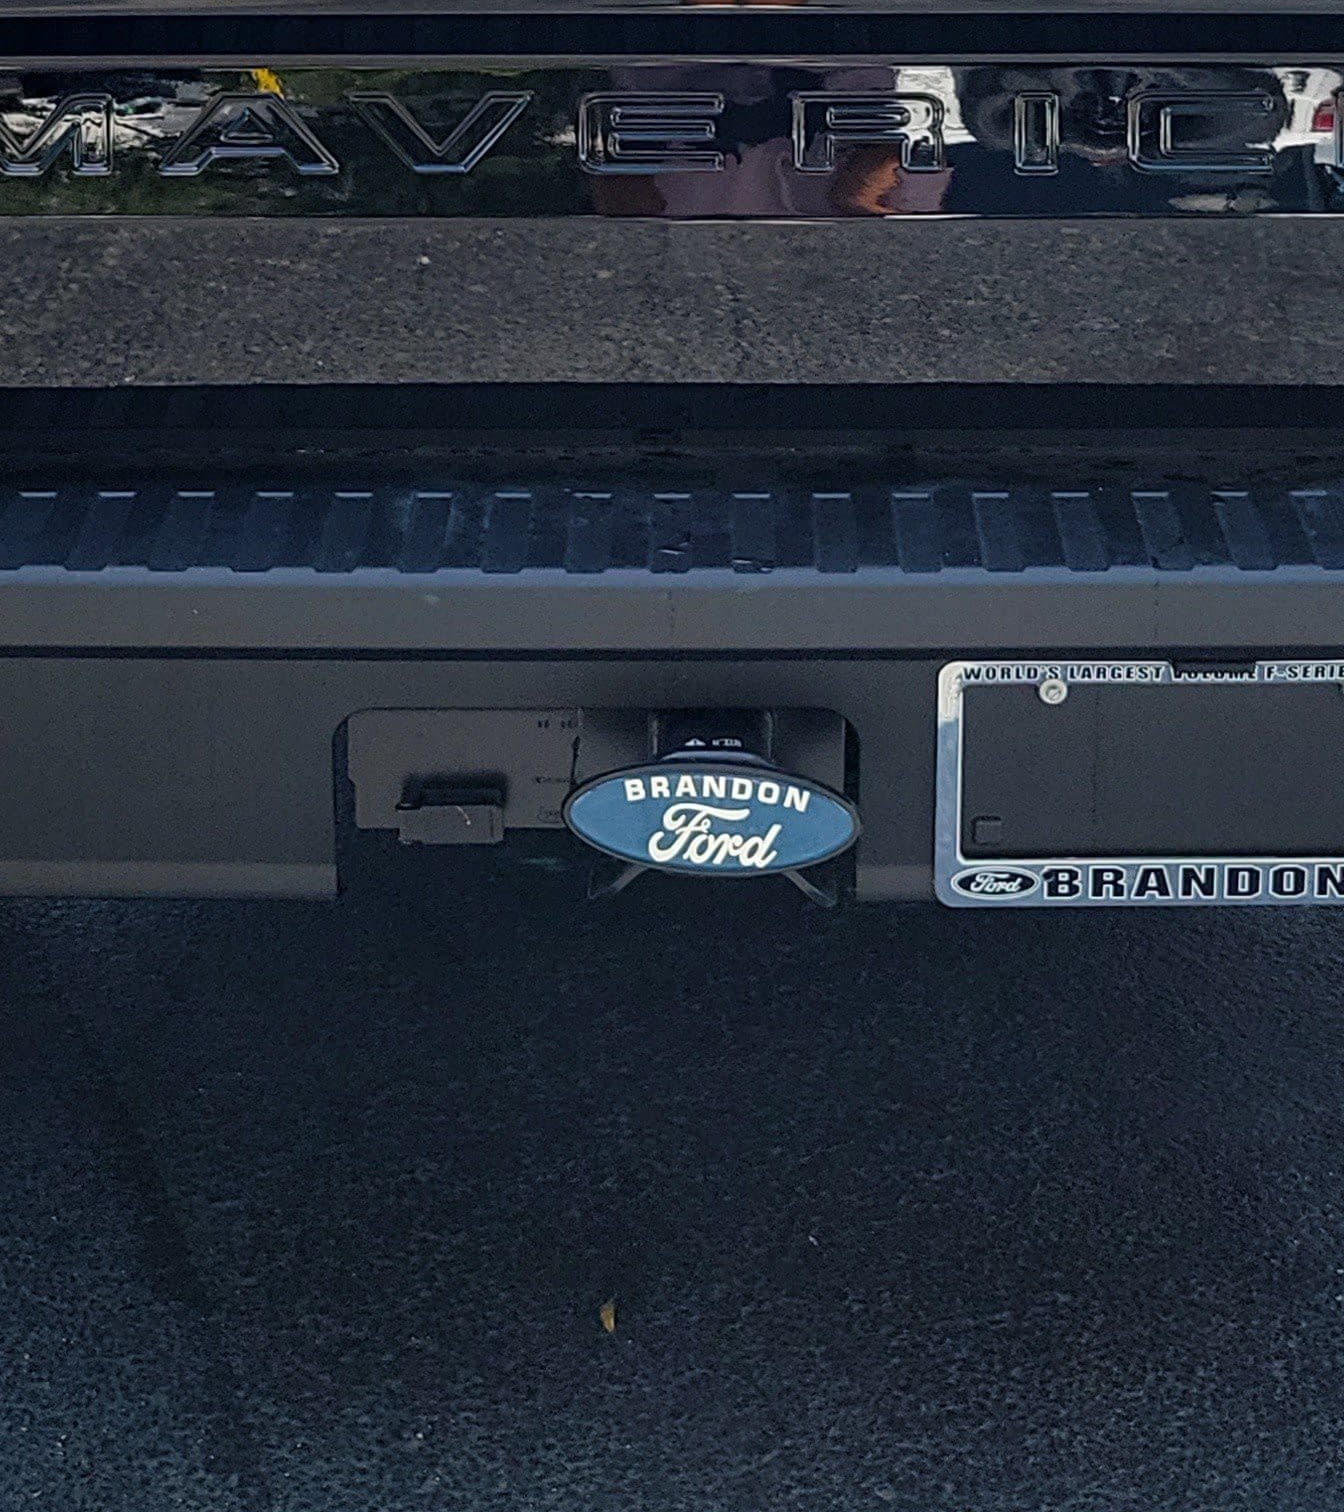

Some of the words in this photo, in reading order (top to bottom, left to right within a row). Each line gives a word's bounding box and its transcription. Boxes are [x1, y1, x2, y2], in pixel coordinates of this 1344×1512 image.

[963, 665, 1060, 681] WORLD'S
[1067, 665, 1165, 681] LARGEST
[623, 774, 811, 813] BRANDON
[647, 801, 783, 869] Ford
[969, 871, 1023, 895] Ford
